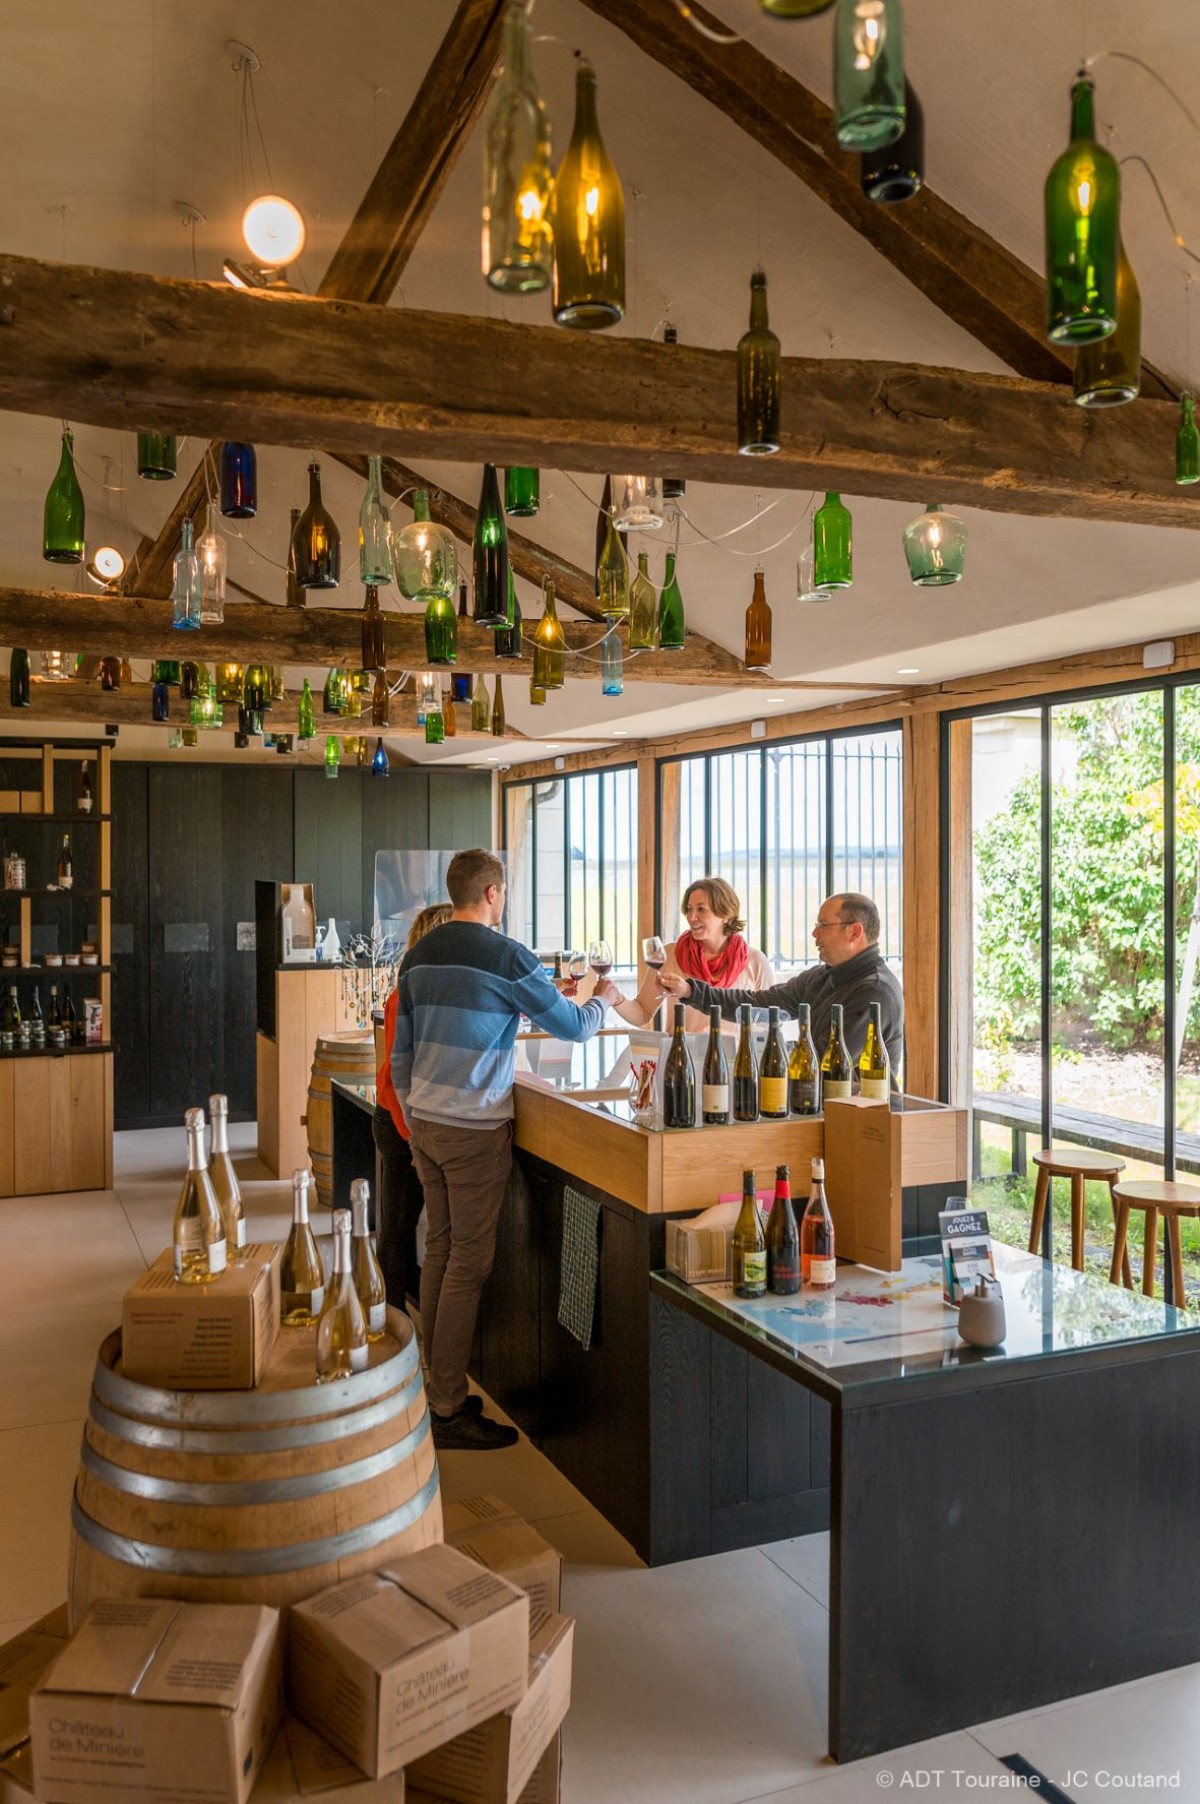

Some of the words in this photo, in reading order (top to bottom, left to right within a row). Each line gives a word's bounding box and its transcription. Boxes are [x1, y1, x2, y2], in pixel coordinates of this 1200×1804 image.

[952, 1215, 969, 1224] JOUEZ
[947, 1222, 982, 1234] GAGNEZ
[48, 1717, 125, 1739] Château
[49, 1737, 73, 1752] de
[76, 1738, 145, 1758] Minière
